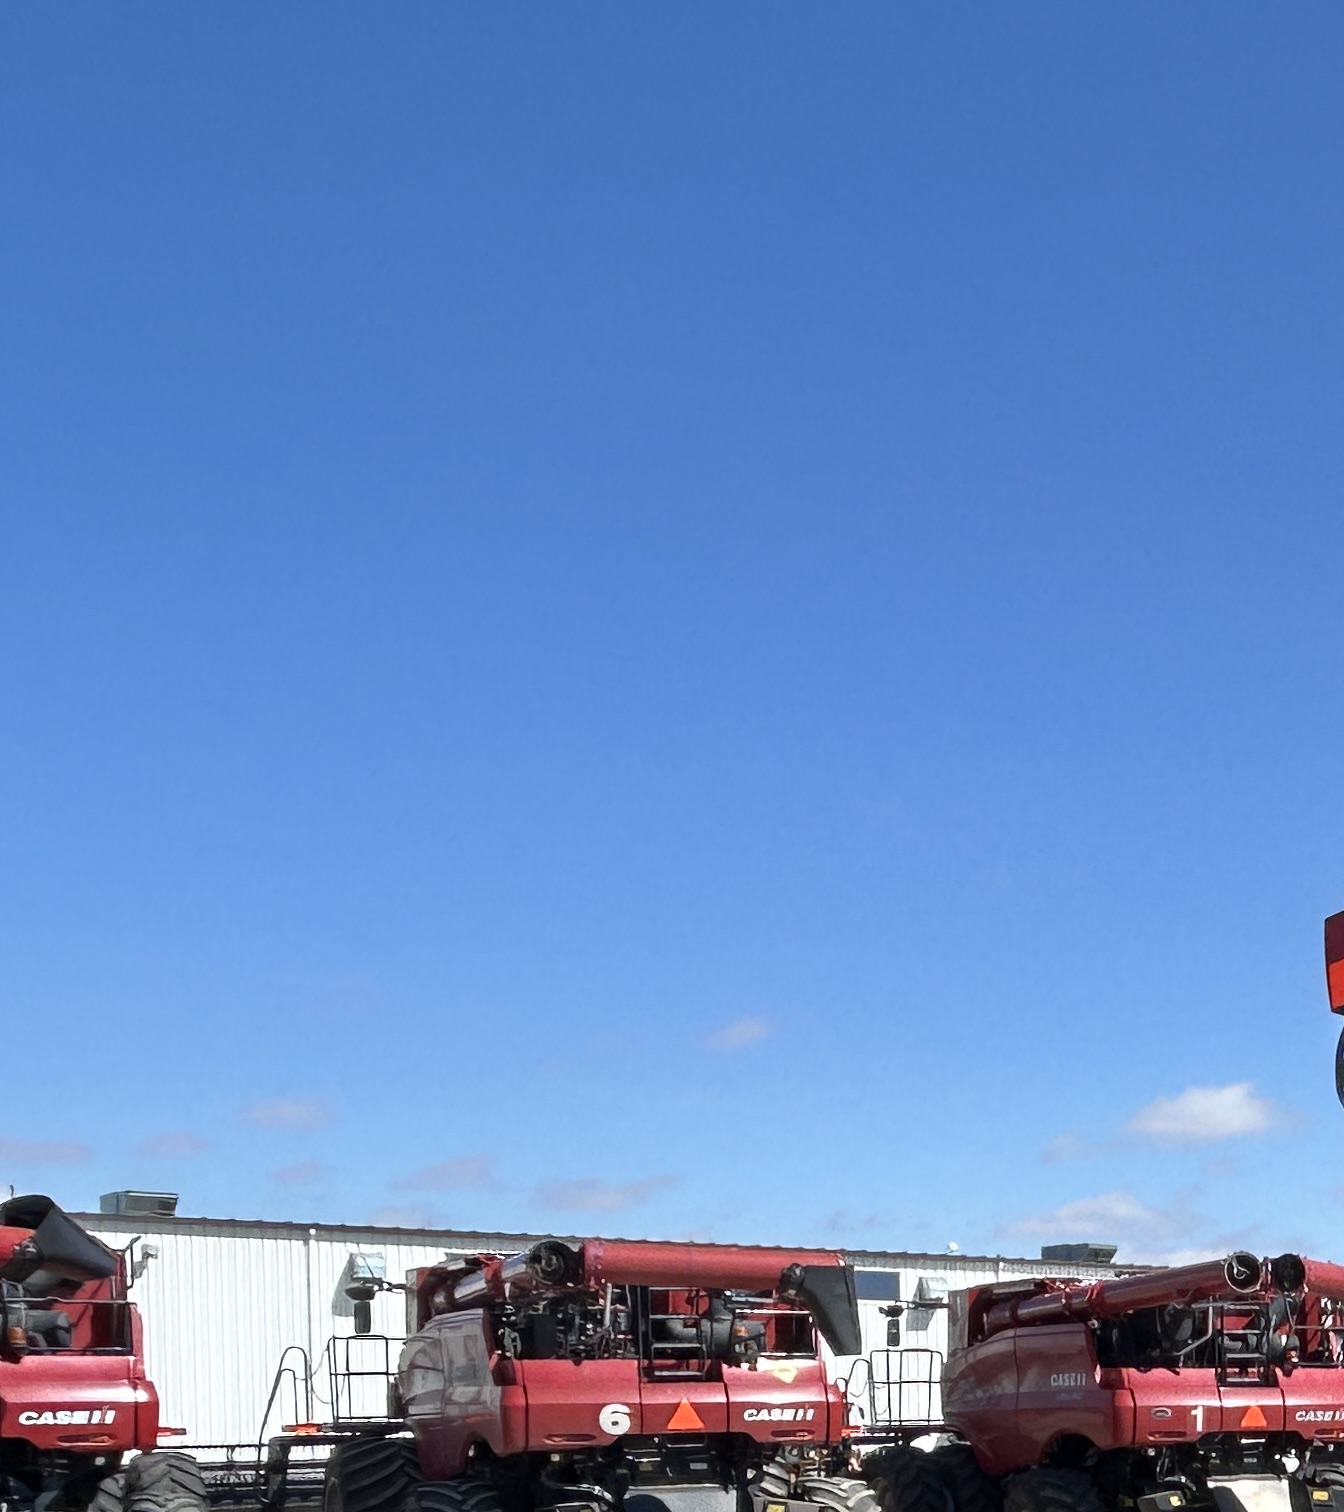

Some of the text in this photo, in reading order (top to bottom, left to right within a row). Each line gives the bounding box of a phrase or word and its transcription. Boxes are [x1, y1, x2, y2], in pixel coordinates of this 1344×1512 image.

[18, 1410, 89, 1426] CASE
[599, 1403, 631, 1436] 6
[743, 1408, 796, 1422] CASE
[1190, 1405, 1204, 1433] 1
